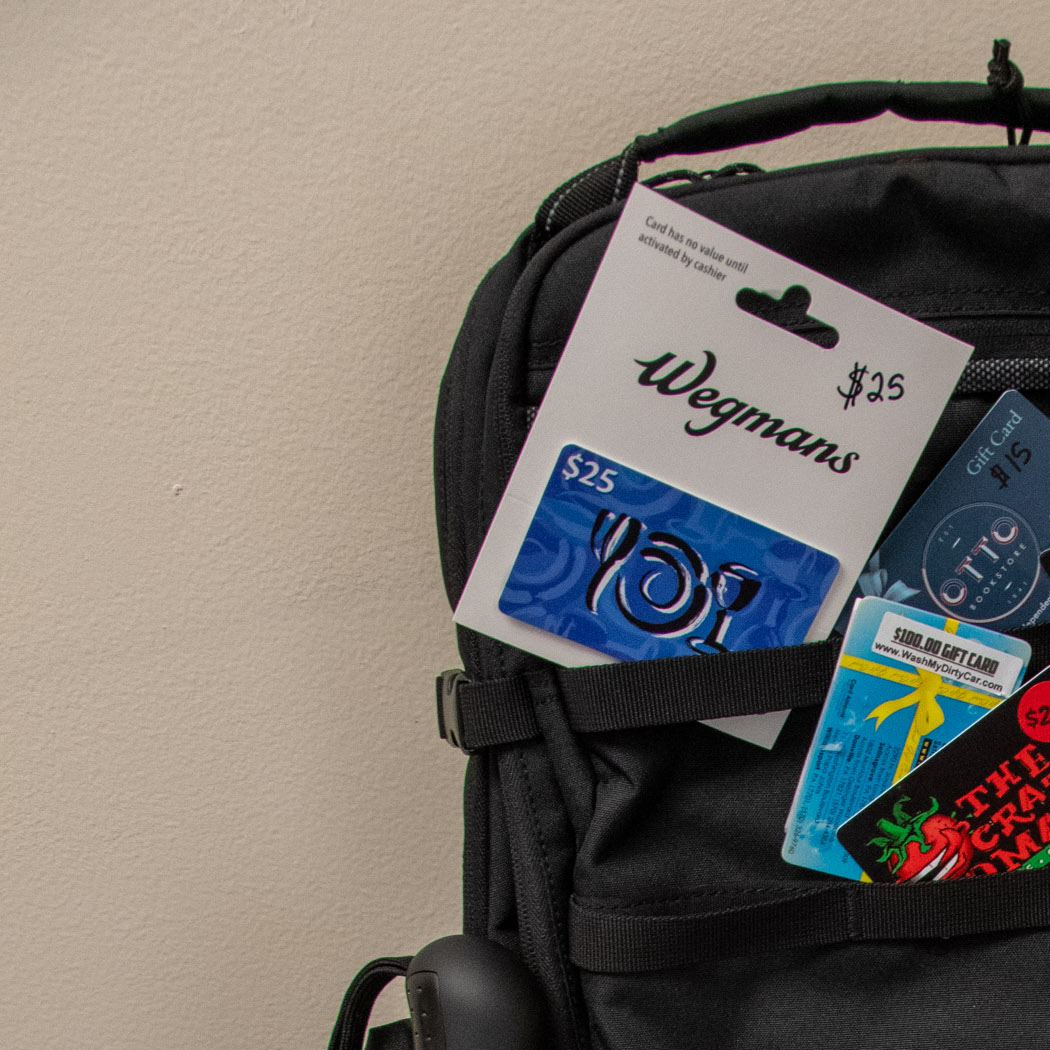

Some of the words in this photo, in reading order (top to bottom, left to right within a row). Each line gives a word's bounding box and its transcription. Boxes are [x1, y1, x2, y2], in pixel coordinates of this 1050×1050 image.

[639, 233, 681, 259] activated
[681, 252, 693, 268] by
[694, 260, 727, 281] cashier
[645, 216, 668, 234] Card
[668, 227, 683, 243] has
[686, 238, 698, 249] no
[700, 246, 724, 262] value
[725, 257, 749, 274] until
[634, 350, 859, 474] Wegmans
[837, 362, 905, 410] $25
[966, 445, 994, 475] Gift
[990, 409, 1023, 446] Card
[990, 441, 1031, 489] $15
[561, 452, 618, 493] $25
[940, 517, 1018, 606] OTTO
[969, 543, 1027, 610] BOOKSTORE
[874, 642, 1003, 692] www.WashMyDirtyCar.com
[893, 627, 942, 655] $100.00
[943, 643, 969, 662] GIFT
[967, 653, 999, 675] CARD
[955, 744, 1050, 817] THE
